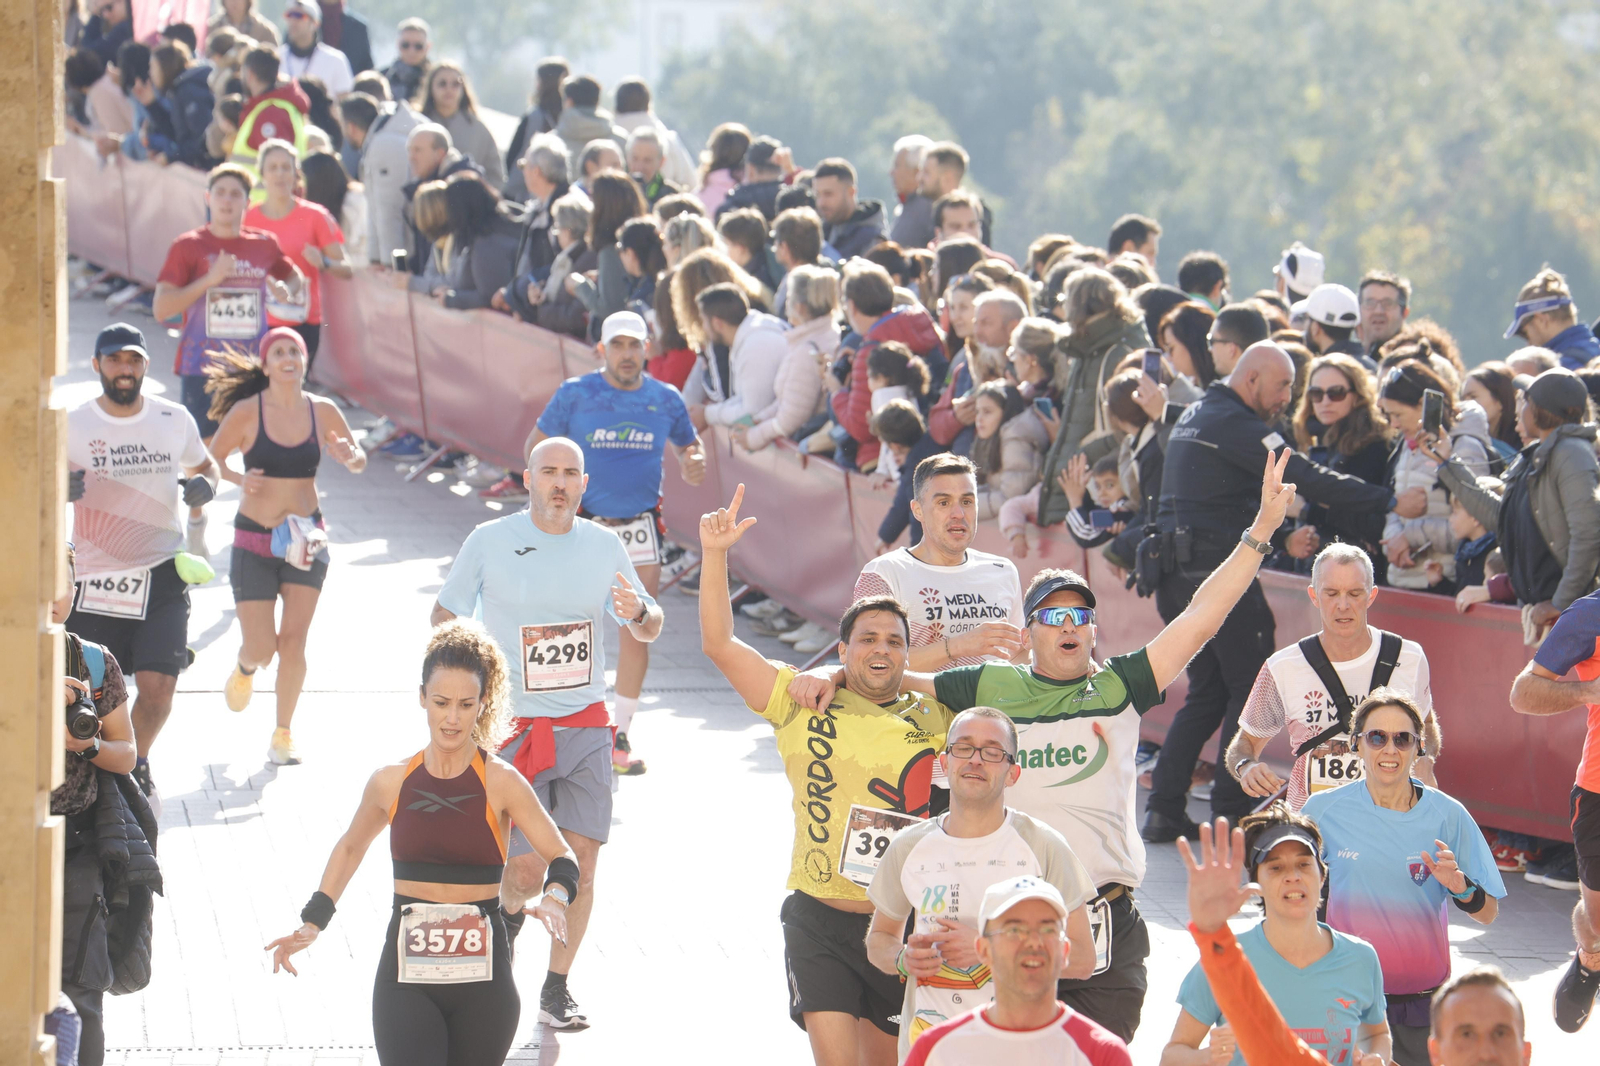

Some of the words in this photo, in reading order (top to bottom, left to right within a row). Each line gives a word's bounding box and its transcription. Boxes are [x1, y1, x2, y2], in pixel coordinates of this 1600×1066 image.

[211, 304, 256, 318] 4456
[110, 443, 148, 456] MEDIA
[92, 456, 107, 468] 37
[112, 450, 171, 467] MARATÓN
[617, 530, 648, 545] 90
[89, 577, 143, 595] 4667
[944, 593, 987, 606] MEDIA
[925, 606, 943, 620] 37
[948, 602, 1007, 620] MARATÓN
[949, 622, 981, 634] CÓRD
[528, 641, 589, 665] 4298
[1327, 694, 1367, 709] MDIA
[1306, 709, 1323, 723] 37
[1016, 742, 1088, 769] natec
[1318, 757, 1366, 780] 186
[855, 831, 891, 859] 39
[920, 885, 948, 915] 28
[409, 928, 482, 953] 3578
